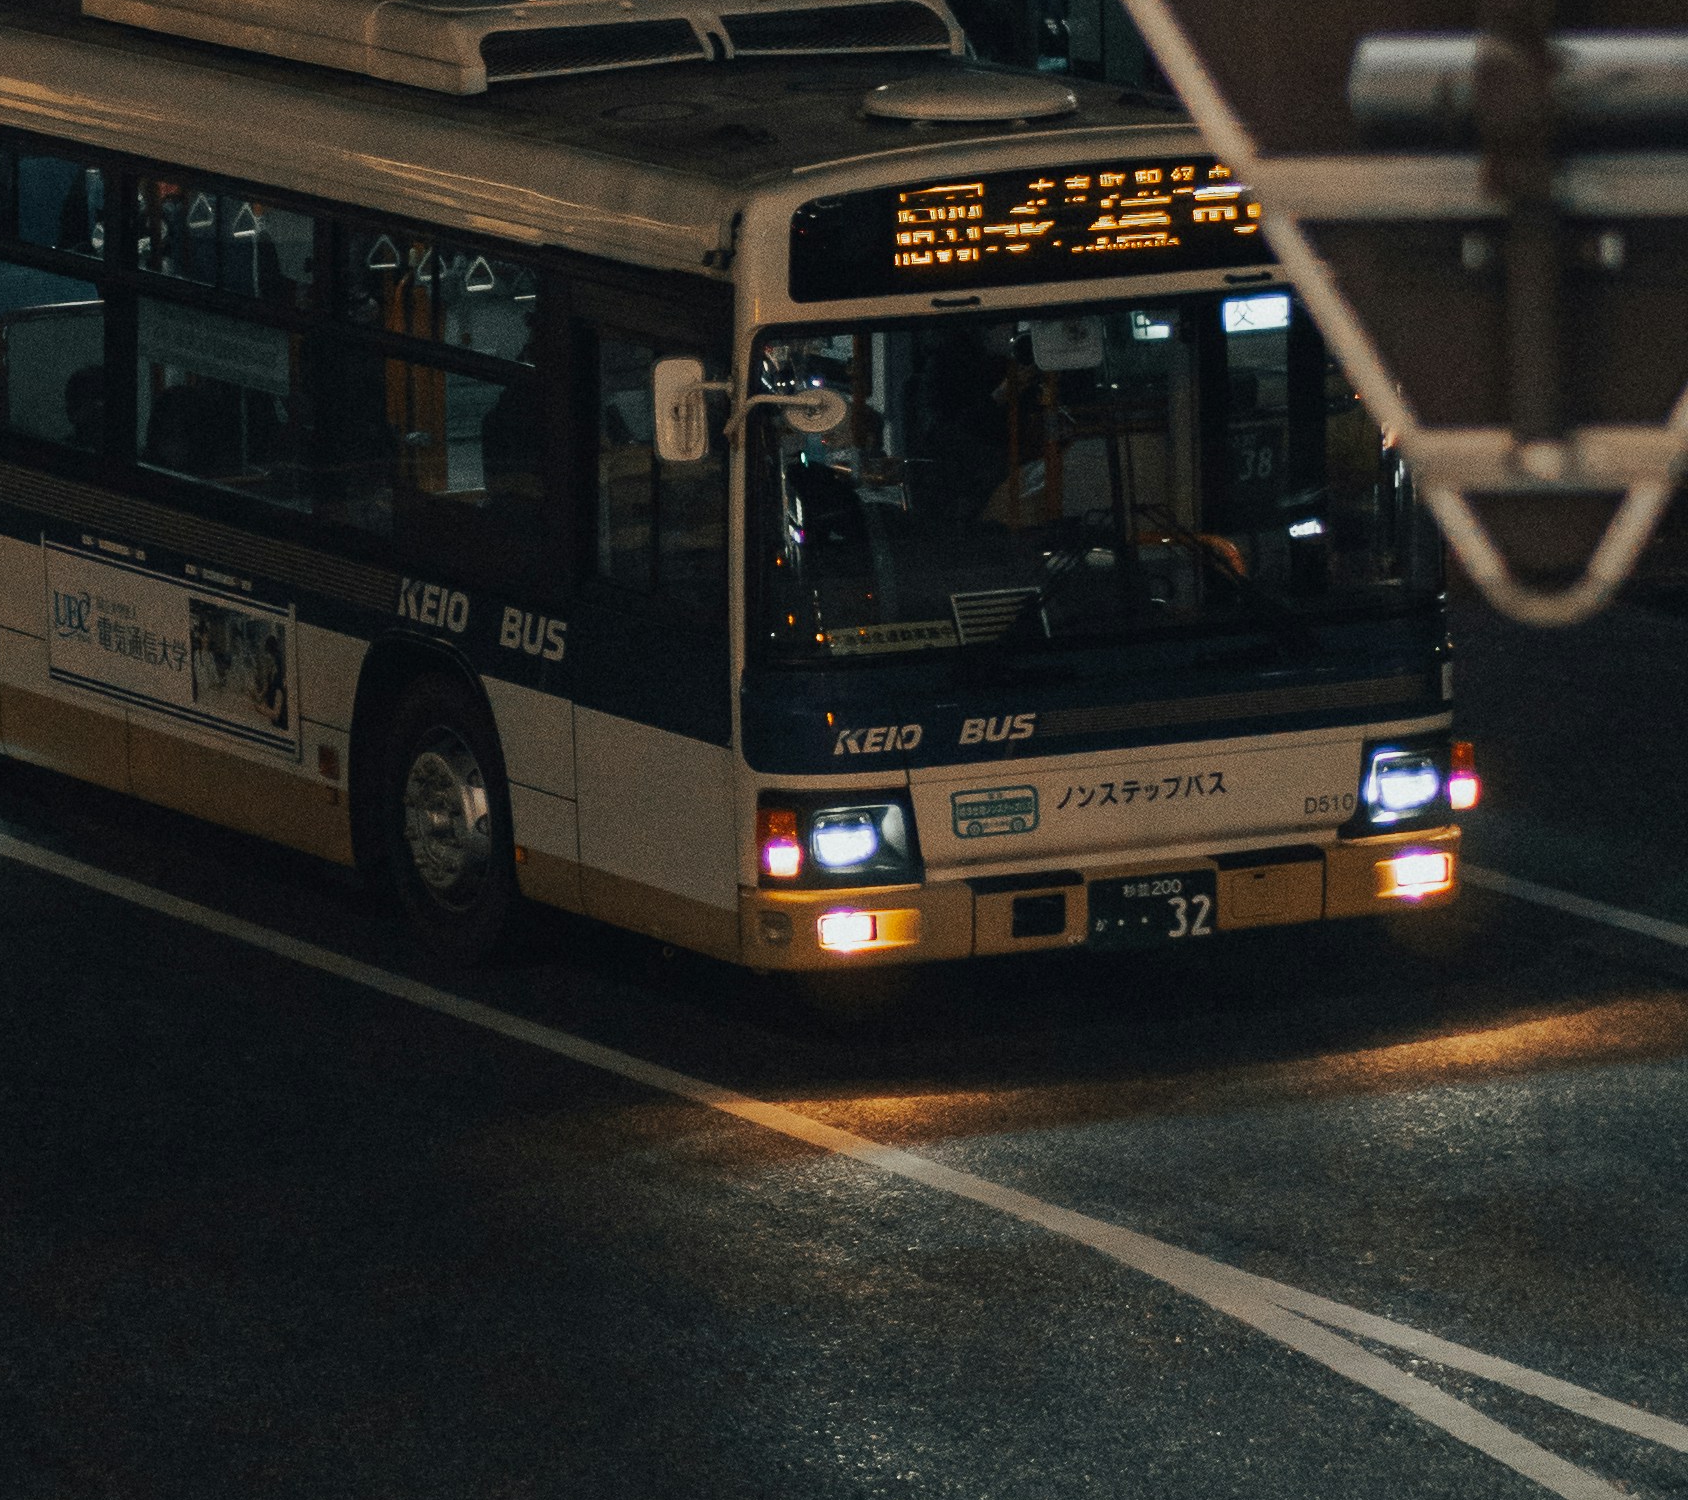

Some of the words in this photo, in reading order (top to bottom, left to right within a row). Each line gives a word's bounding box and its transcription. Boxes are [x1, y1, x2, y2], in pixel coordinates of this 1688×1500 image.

[97, 616, 187, 671] 電気通信大学
[397, 577, 470, 633] KEIO
[499, 606, 568, 662] BUS
[833, 724, 924, 756] KEIO
[958, 713, 1037, 745] BUS
[1057, 772, 1227, 809] ノンステップバス
